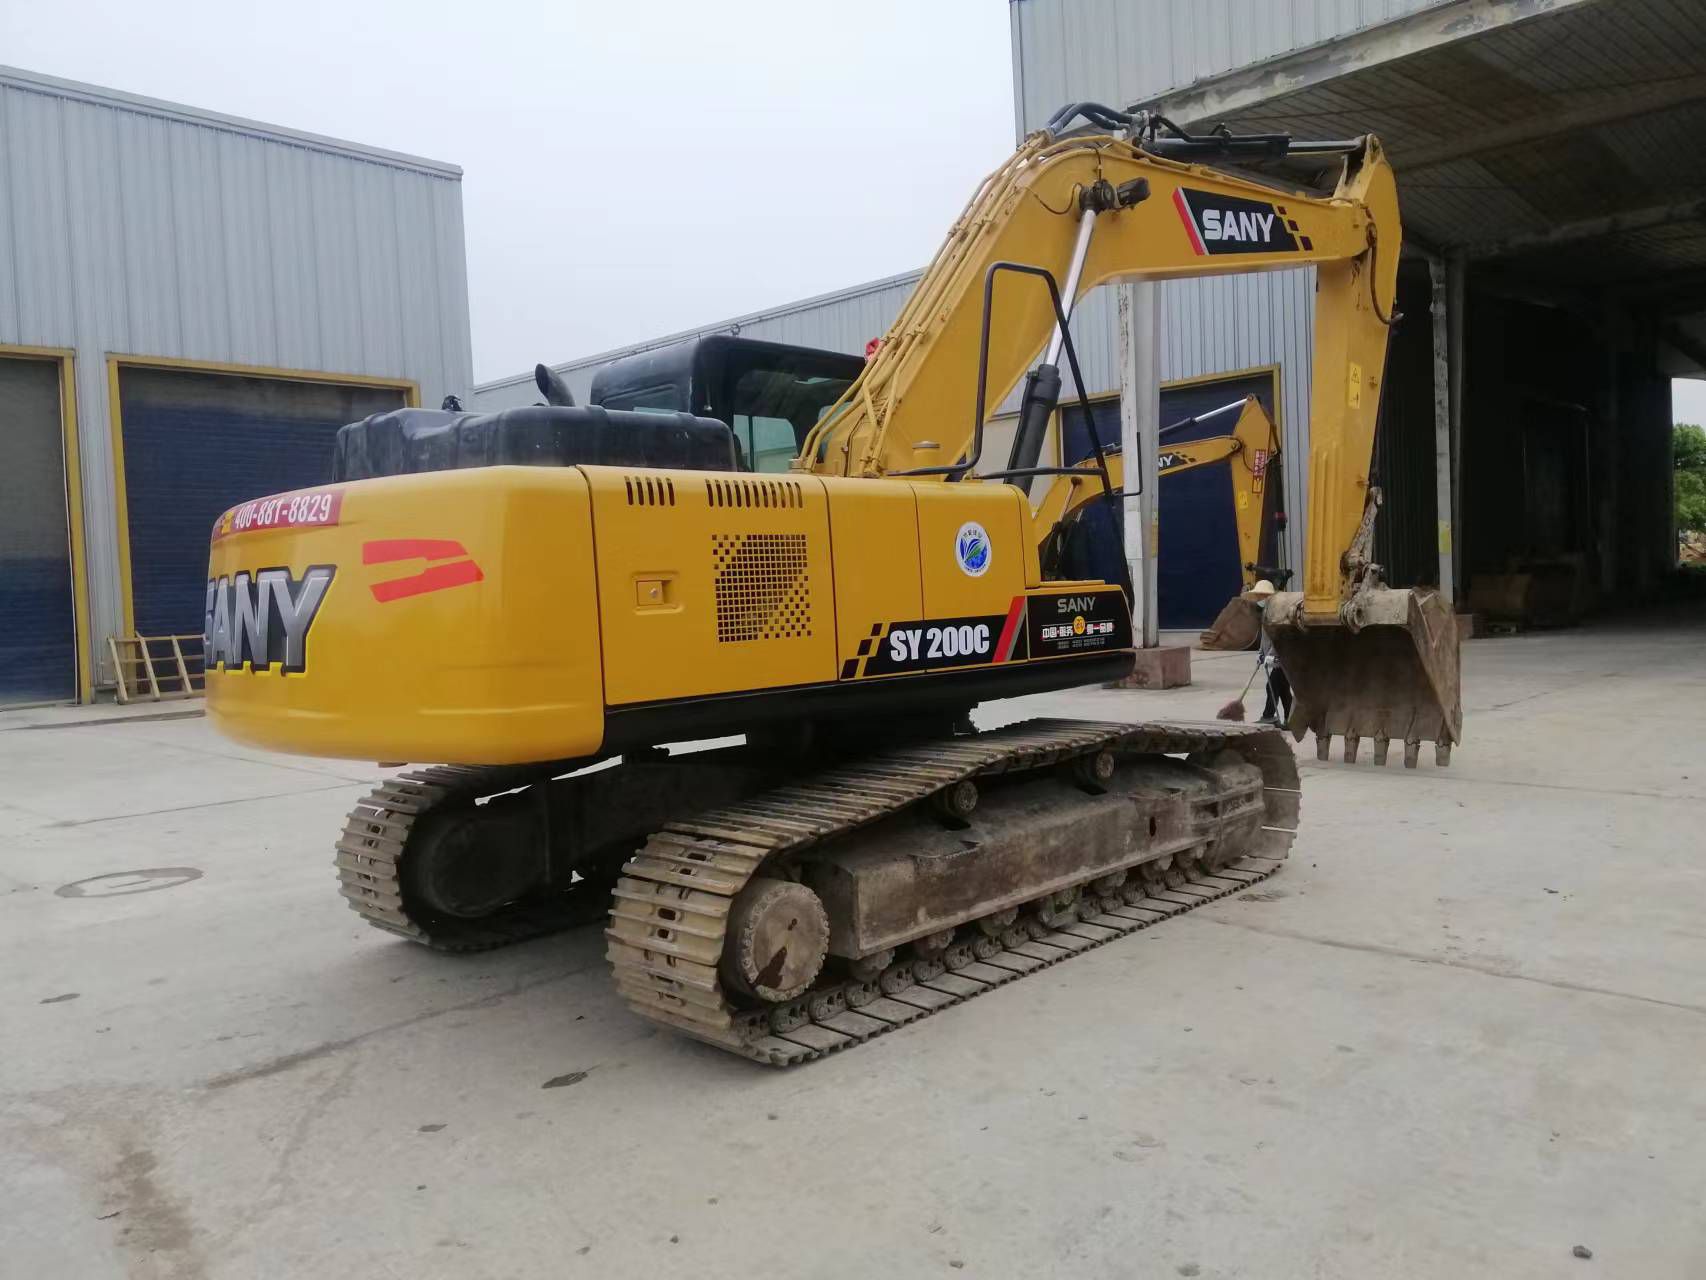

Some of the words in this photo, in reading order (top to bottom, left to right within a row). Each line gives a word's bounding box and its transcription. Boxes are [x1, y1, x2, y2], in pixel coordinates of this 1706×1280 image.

[1202, 208, 1274, 243] SANY
[1057, 597, 1096, 613] SANY
[890, 629, 922, 662] SY
[926, 624, 989, 659] 200C
